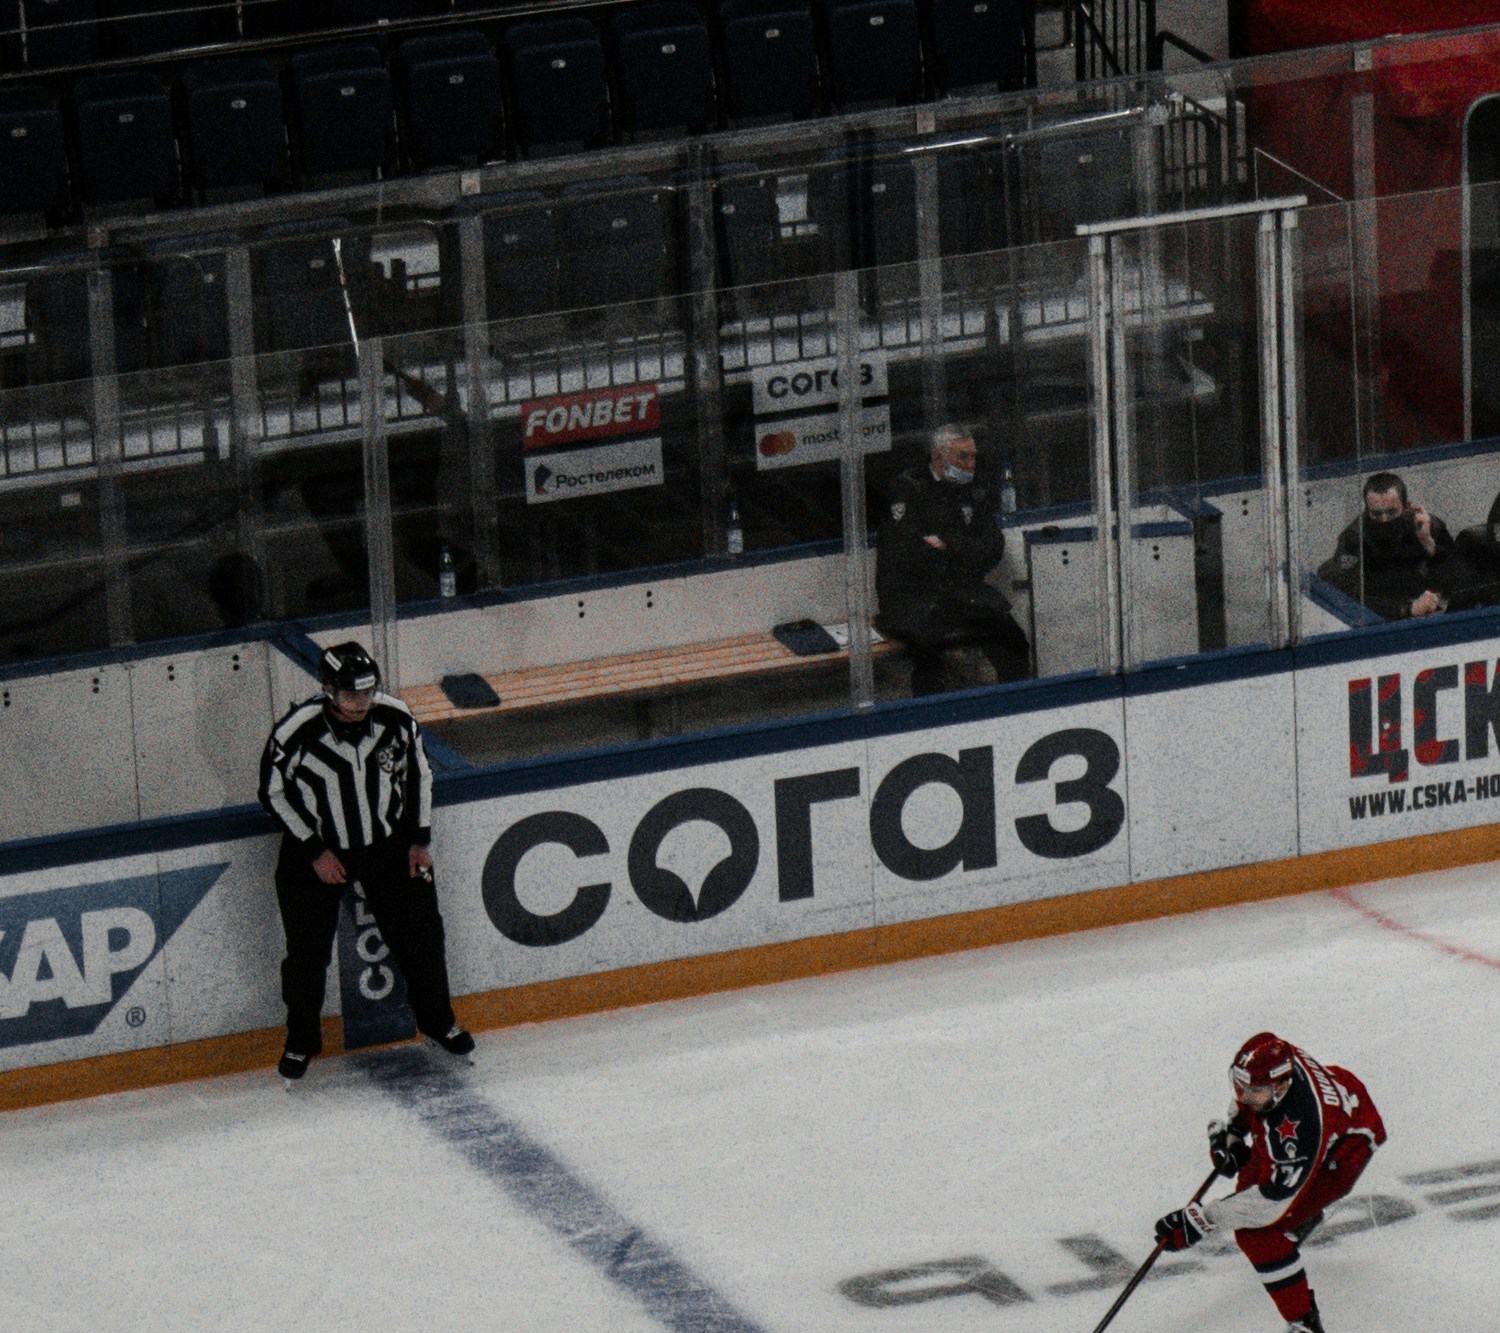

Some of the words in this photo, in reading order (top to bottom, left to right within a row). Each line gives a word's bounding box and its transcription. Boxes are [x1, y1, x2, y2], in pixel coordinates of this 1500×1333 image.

[524, 391, 656, 438] FONBET
[555, 462, 656, 489] Ростелеком
[0, 905, 157, 1021] AP
